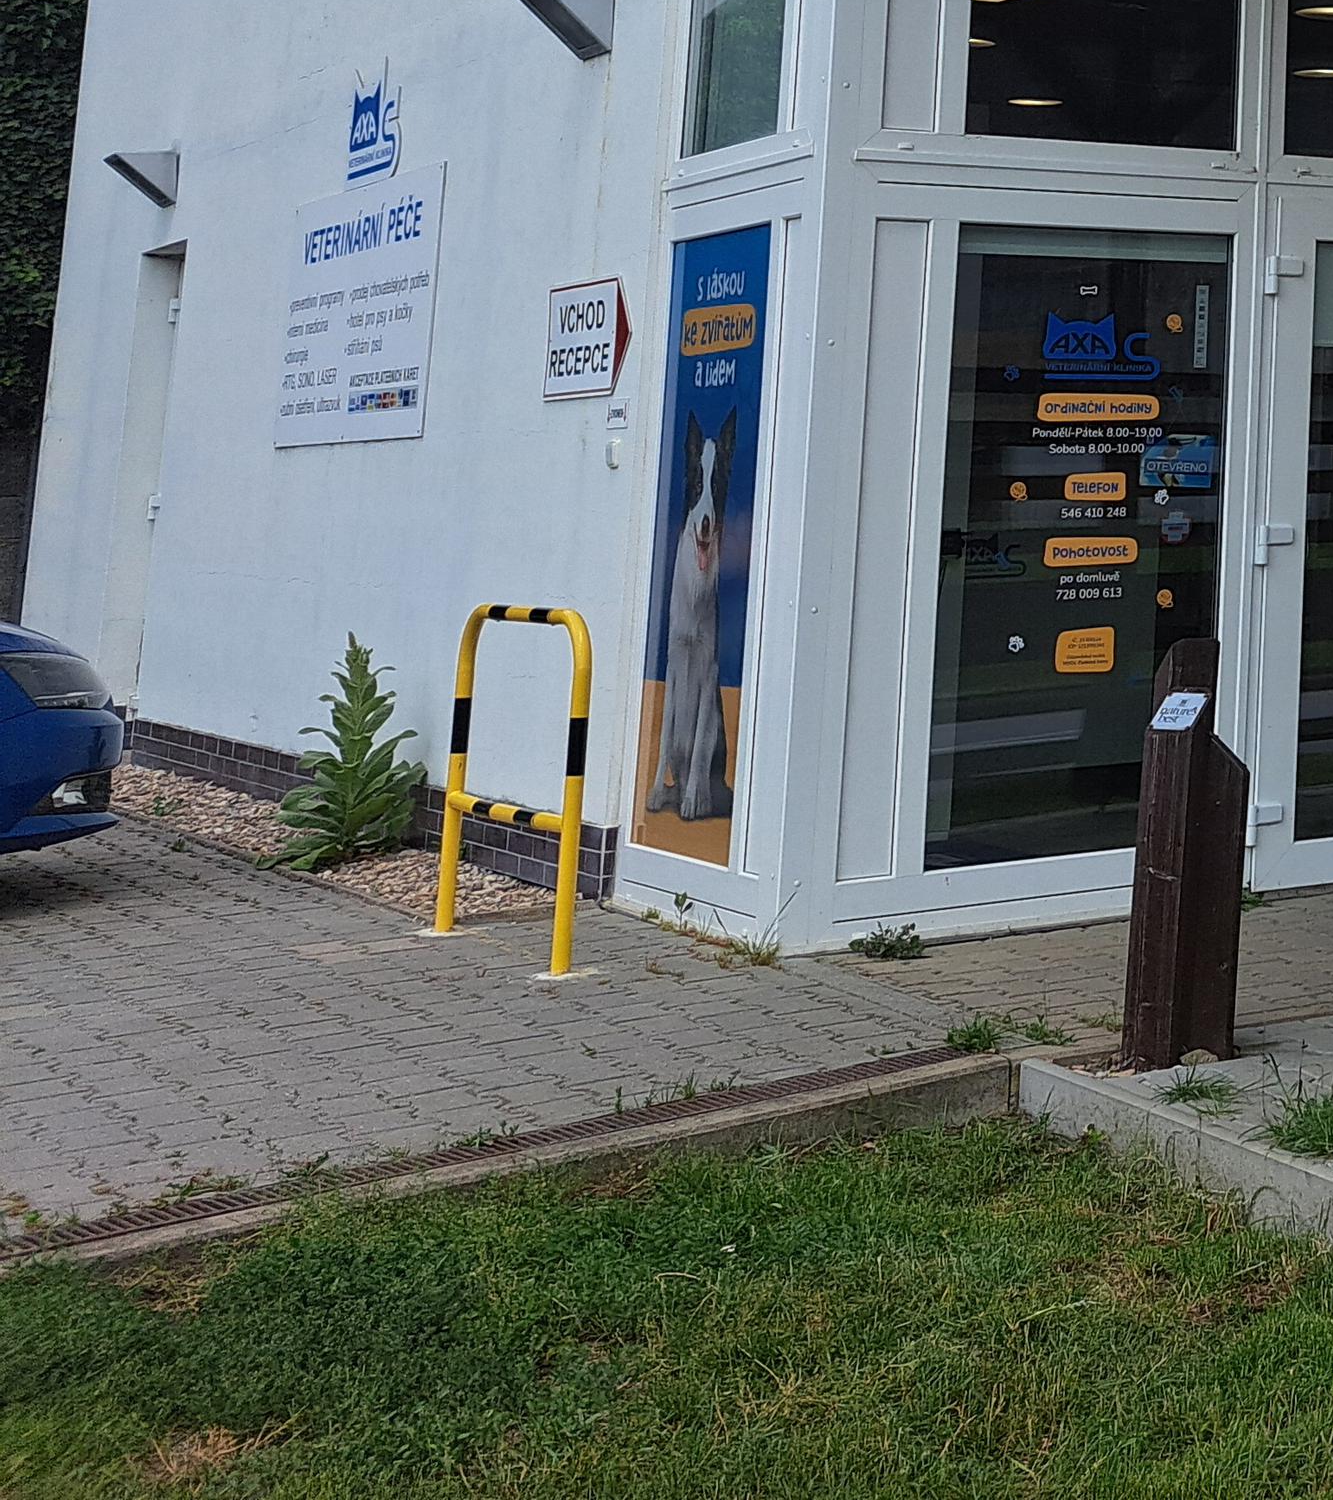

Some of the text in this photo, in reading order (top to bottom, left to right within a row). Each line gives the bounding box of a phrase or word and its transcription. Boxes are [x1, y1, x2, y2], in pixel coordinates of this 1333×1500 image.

[352, 111, 377, 146] AXA
[305, 194, 423, 265] VETERINÁRNÍ PÉČE
[560, 300, 605, 334] VCHOD
[1050, 332, 1110, 354] AXA
[549, 343, 610, 378] RECEPCE
[1032, 427, 1104, 438] Pondělí-Pátek
[1049, 443, 1086, 454] Sobota
[1146, 461, 1208, 473] OTEVŘENO
[1060, 507, 1127, 519] 546 410 248
[1060, 570, 1121, 586] po domluvě
[1055, 587, 1122, 601] 728 009 613
